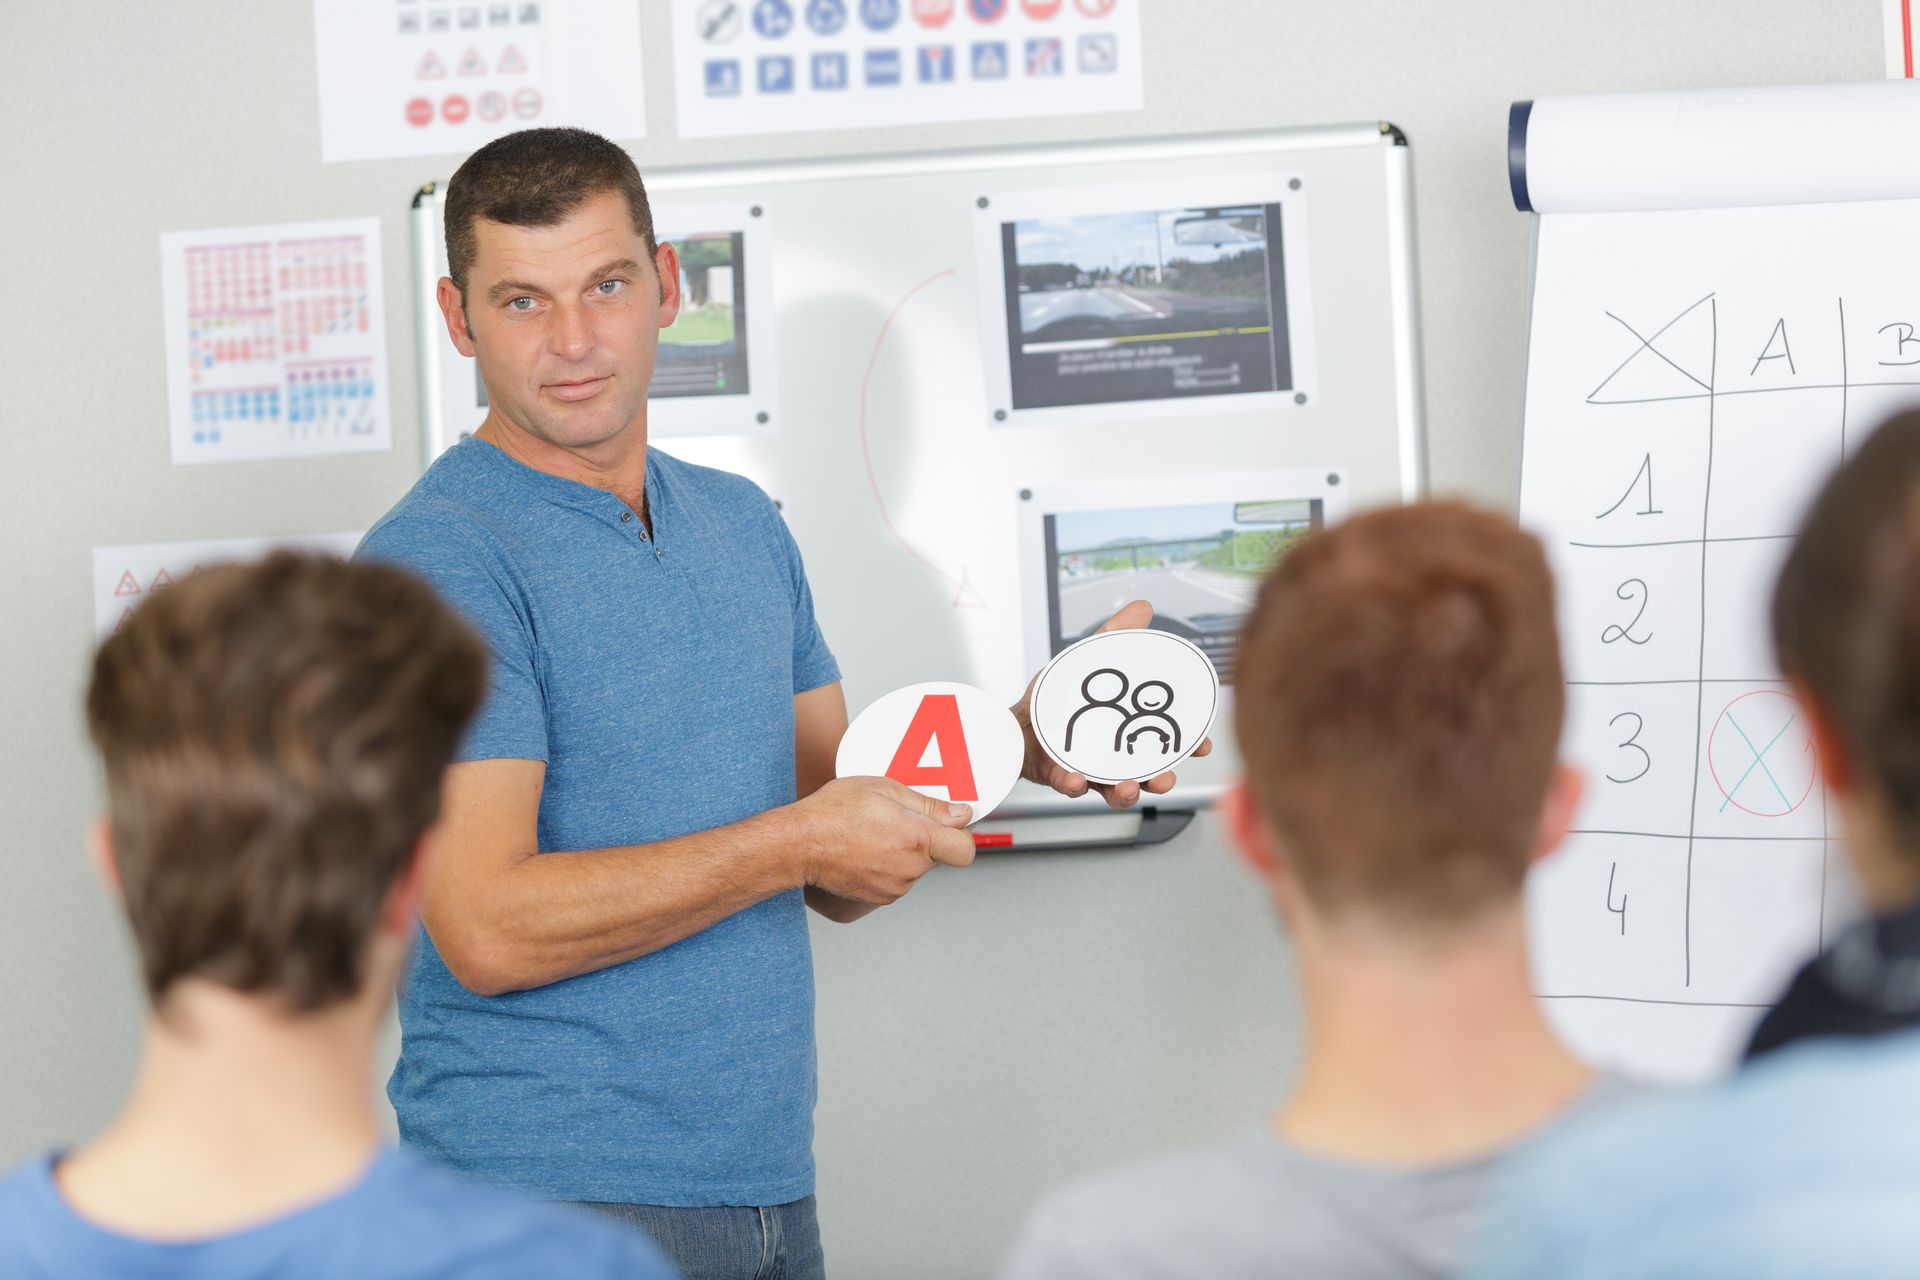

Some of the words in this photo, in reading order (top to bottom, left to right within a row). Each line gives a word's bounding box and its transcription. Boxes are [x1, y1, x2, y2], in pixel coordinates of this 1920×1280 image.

[1749, 317, 1797, 377] A
[1595, 451, 1664, 520] 1
[1600, 577, 1654, 645] 2
[884, 694, 979, 801] A
[1605, 711, 1651, 784] 3
[1606, 861, 1628, 937] 4
